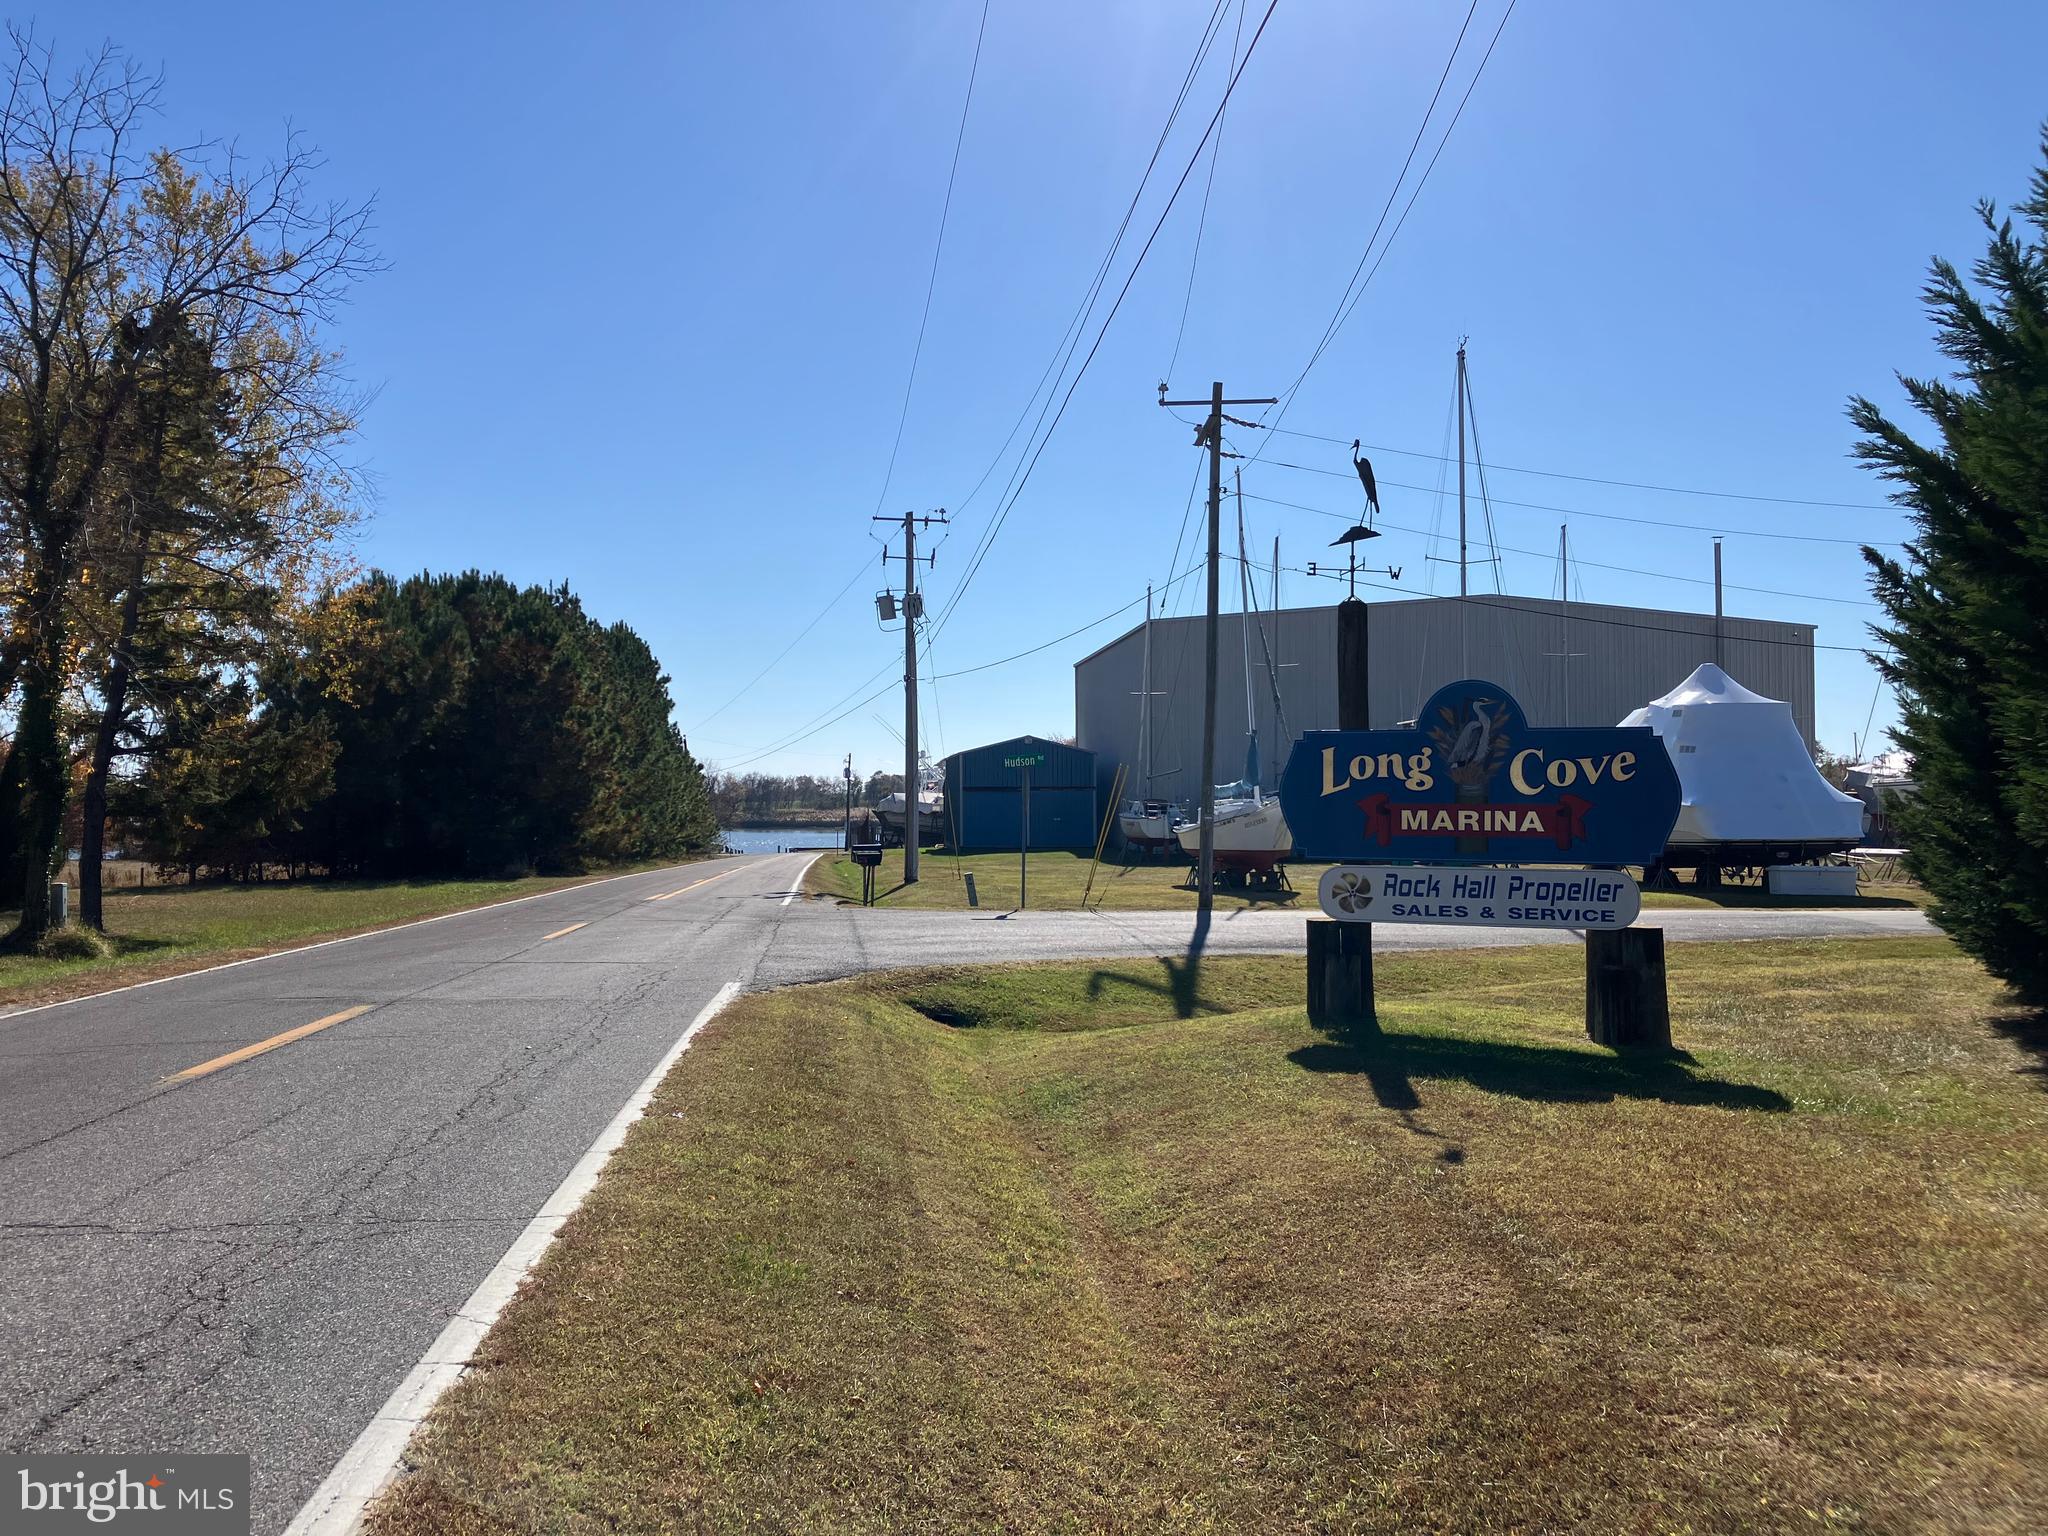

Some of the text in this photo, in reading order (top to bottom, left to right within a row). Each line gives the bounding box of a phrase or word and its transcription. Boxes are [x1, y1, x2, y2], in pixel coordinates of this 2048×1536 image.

[1004, 757, 1035, 767] Hudson
[1319, 746, 1637, 797] Long Cove
[1401, 808, 1545, 832] MARINA
[1383, 873, 1625, 906] Rock Hall Propeller
[1391, 903, 1616, 922] SALES & SERVICE
